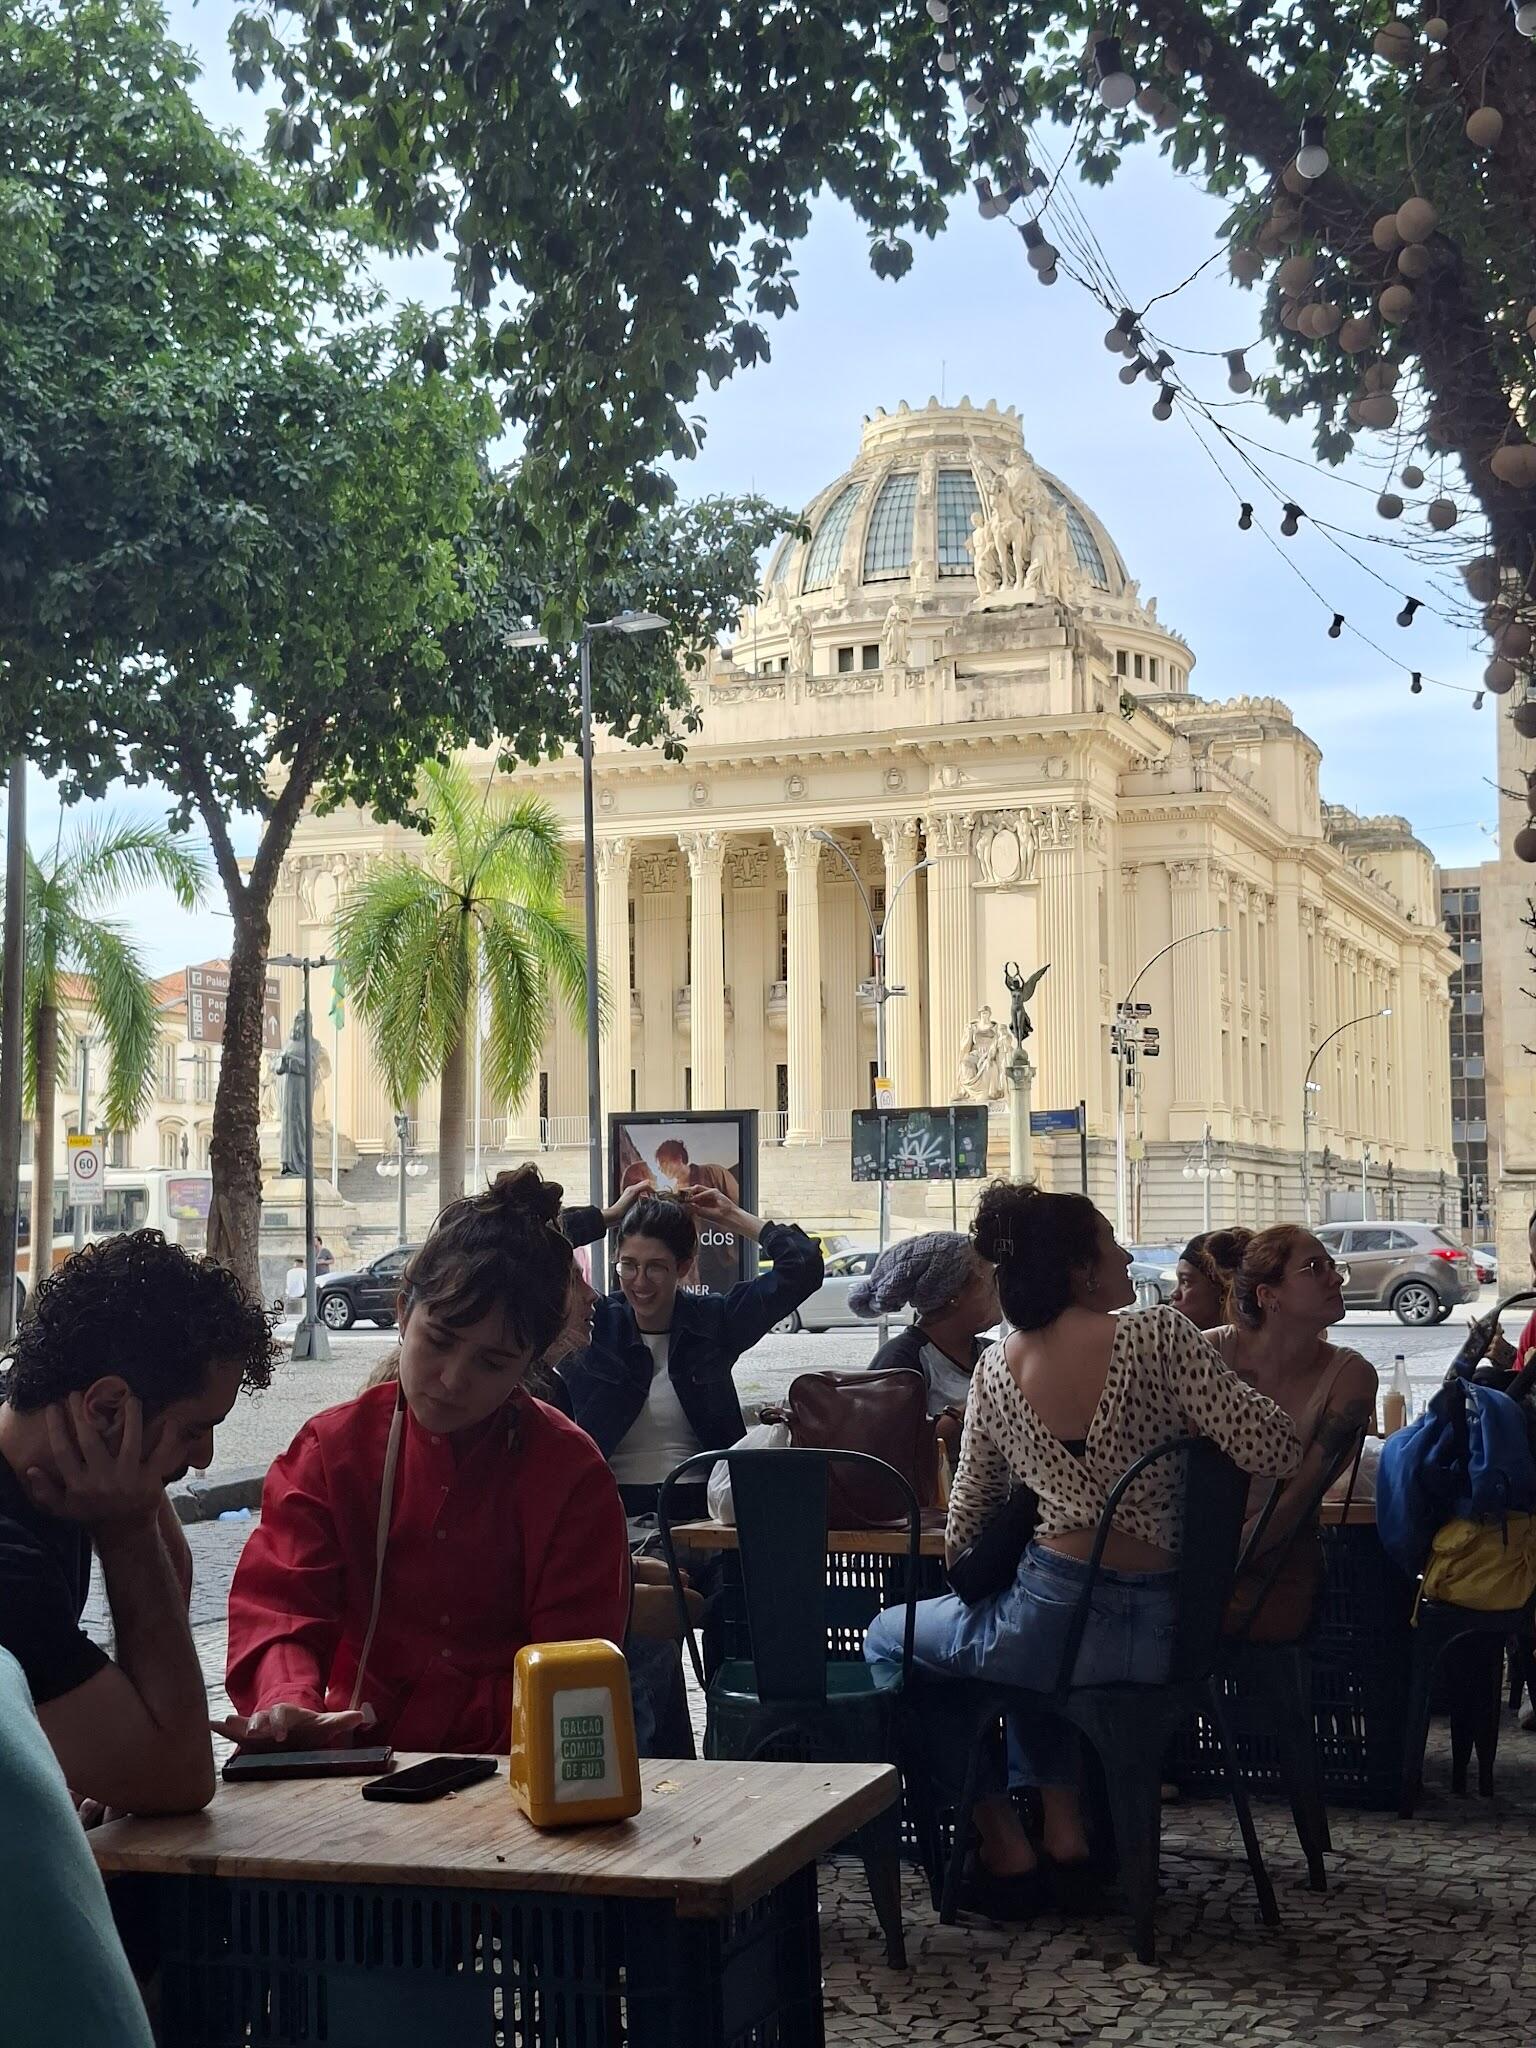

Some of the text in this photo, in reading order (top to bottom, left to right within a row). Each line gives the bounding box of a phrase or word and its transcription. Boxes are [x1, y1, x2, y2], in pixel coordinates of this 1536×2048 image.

[208, 1012, 220, 1023] CC
[79, 1158, 93, 1169] 60
[700, 1228, 735, 1246] dos
[563, 1741, 602, 1758] COMIDA
[566, 1761, 601, 1779] DE RUA
